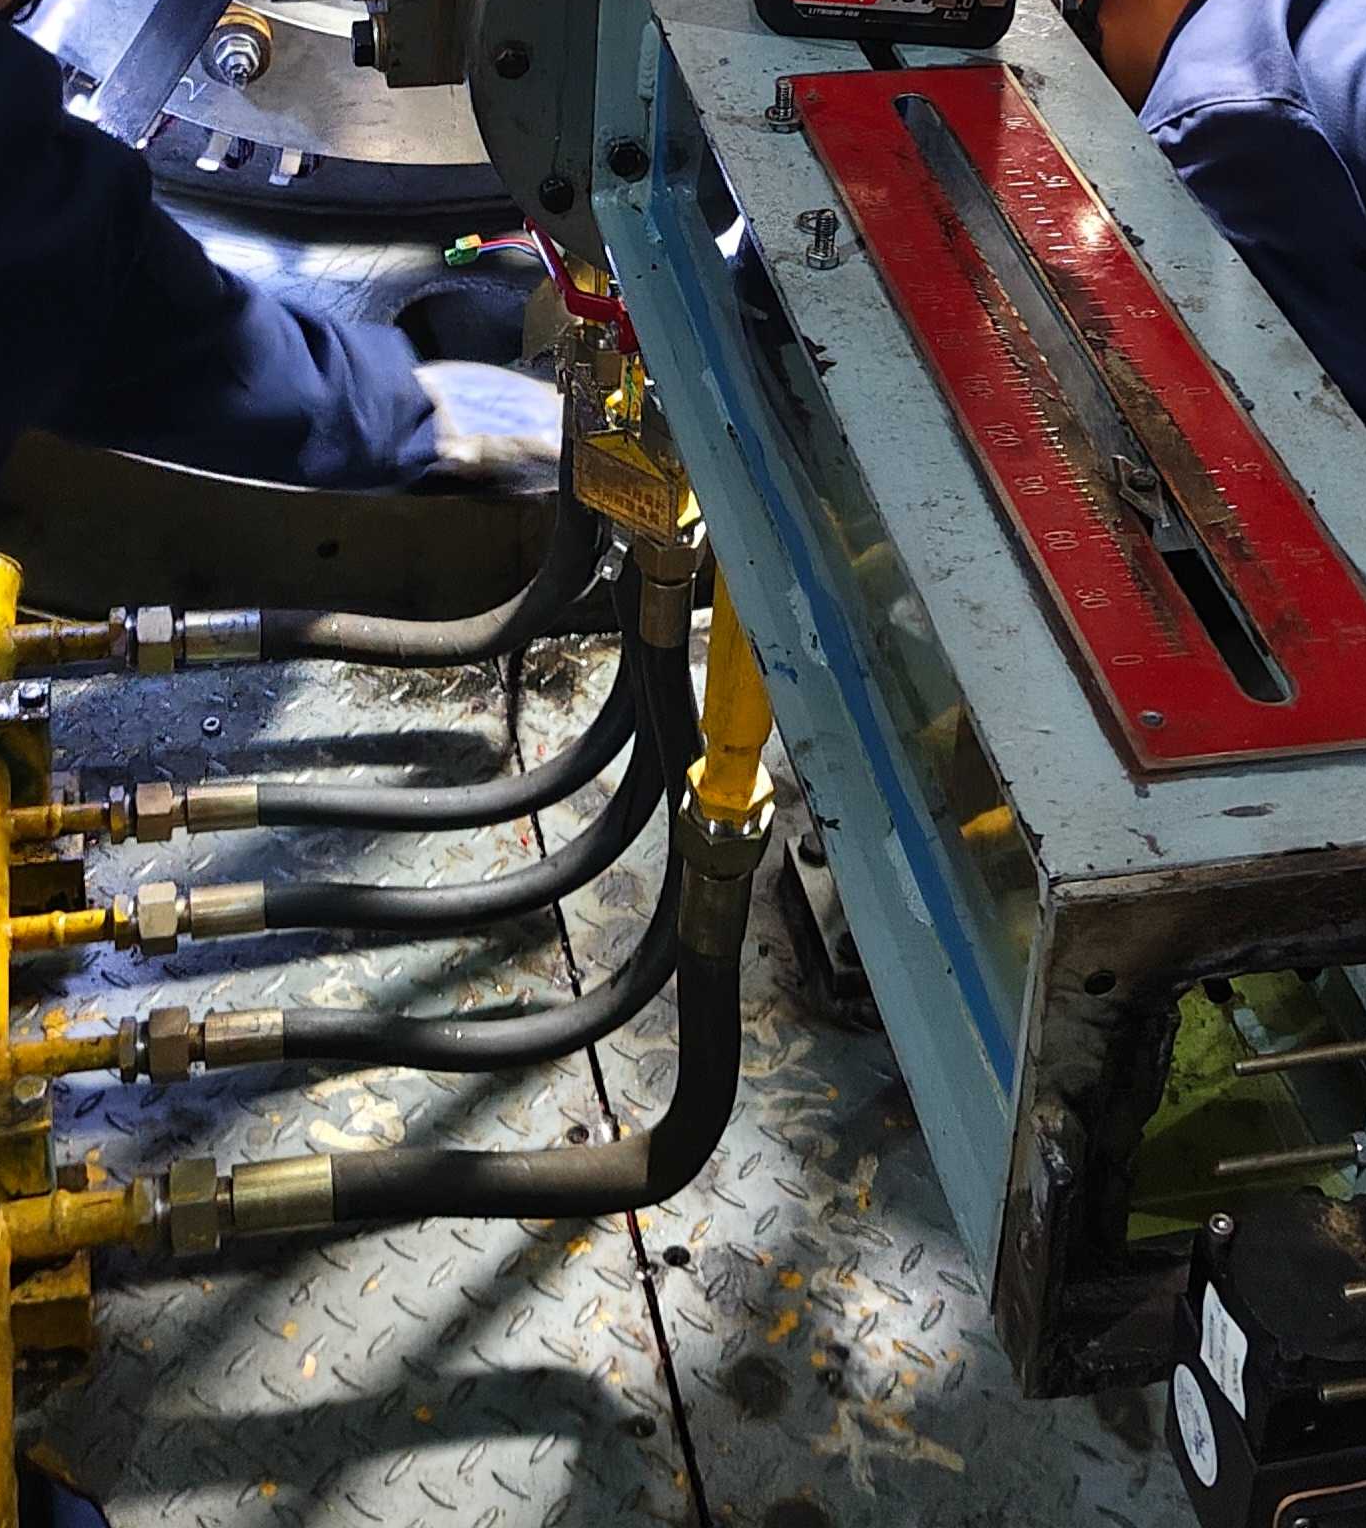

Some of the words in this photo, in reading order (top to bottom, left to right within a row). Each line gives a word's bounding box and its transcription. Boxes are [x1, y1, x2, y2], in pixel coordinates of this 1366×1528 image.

[983, 422, 1023, 448] 120
[1014, 474, 1050, 496] 90
[1042, 529, 1080, 551] 60
[1075, 587, 1112, 610] 30
[1111, 653, 1144, 667] 0
